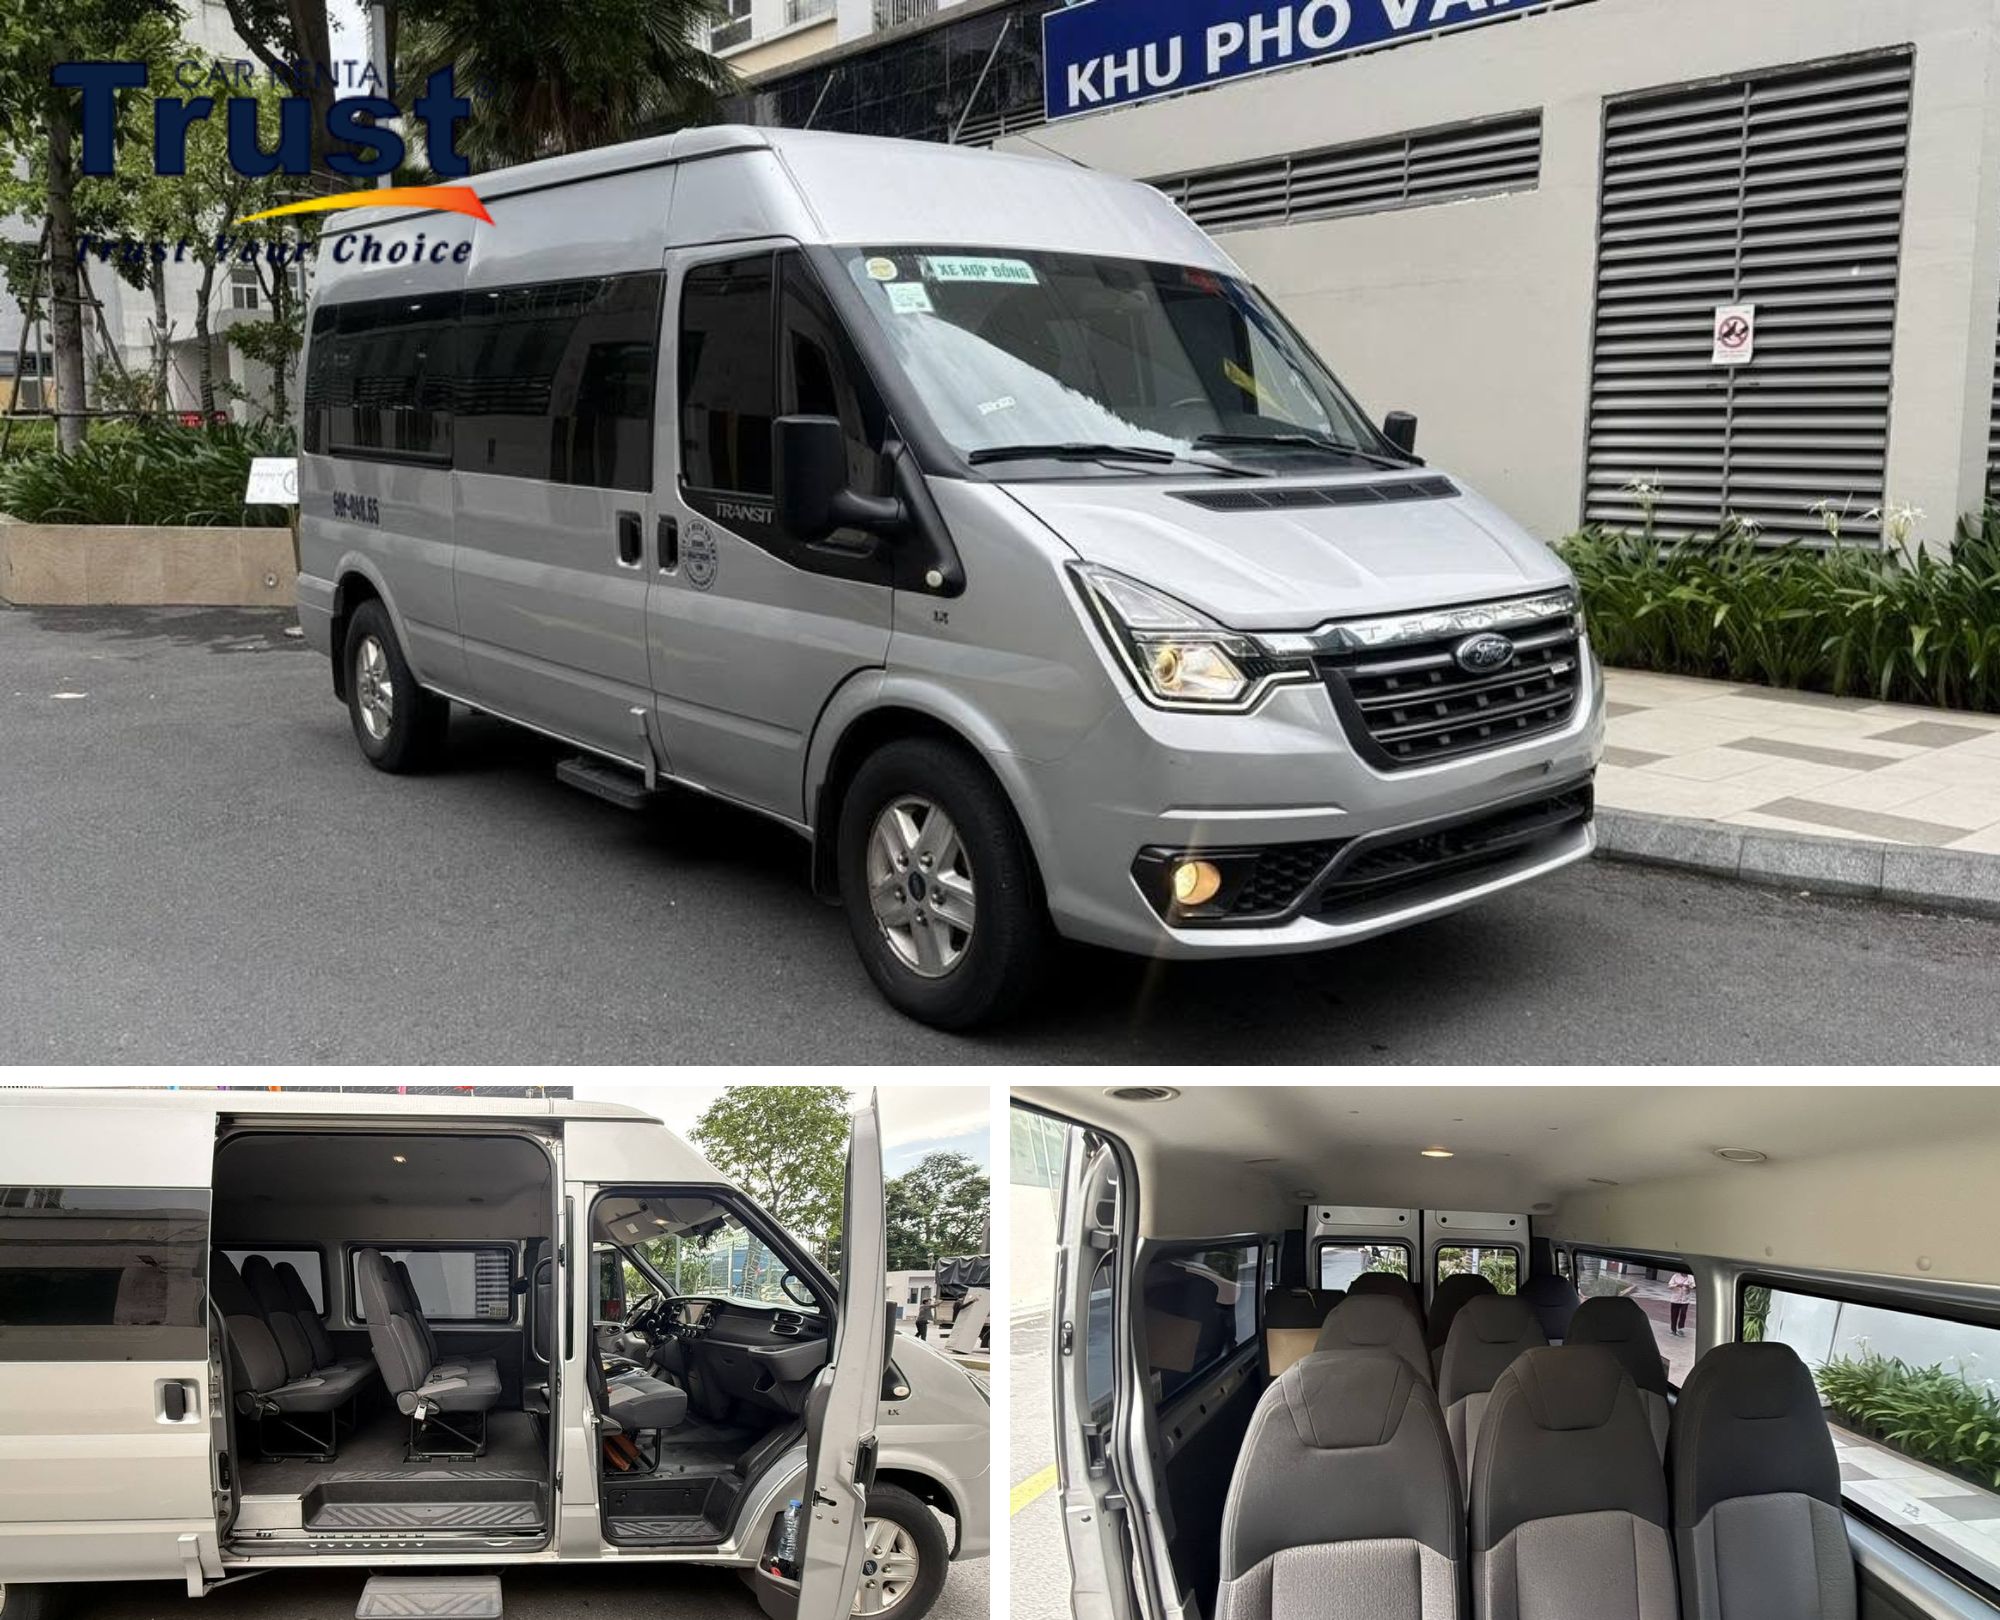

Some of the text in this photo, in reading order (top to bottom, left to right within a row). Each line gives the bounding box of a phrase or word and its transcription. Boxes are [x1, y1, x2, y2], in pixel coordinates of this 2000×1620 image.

[1067, 36, 1183, 107] KHU
[937, 264, 959, 276] XE
[716, 502, 774, 525] TRANSIT
